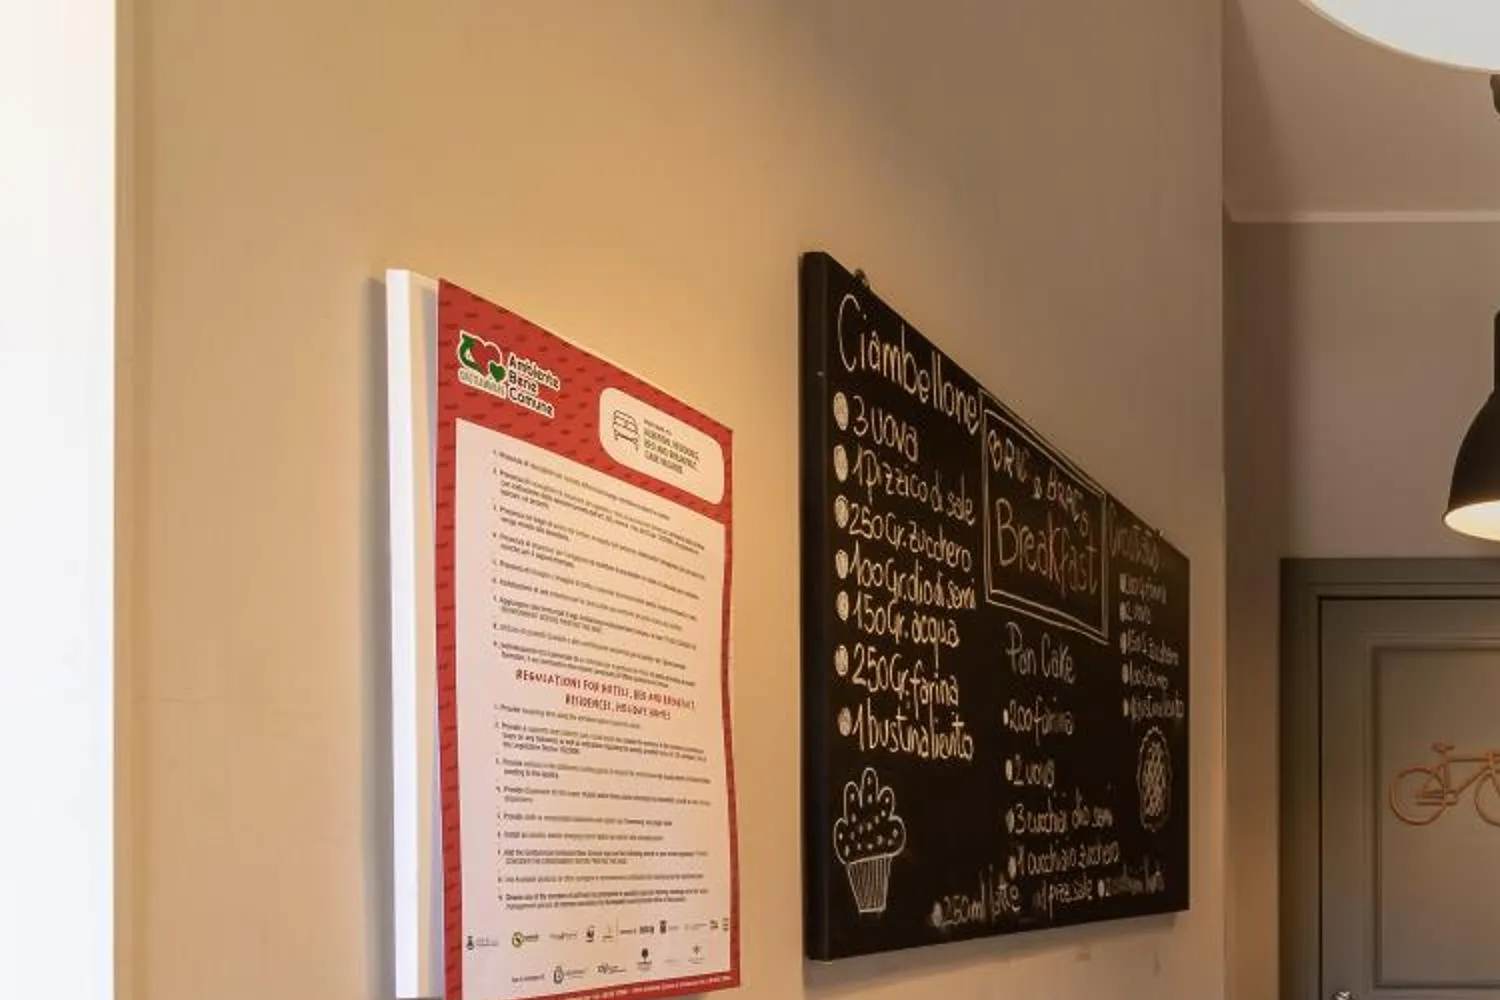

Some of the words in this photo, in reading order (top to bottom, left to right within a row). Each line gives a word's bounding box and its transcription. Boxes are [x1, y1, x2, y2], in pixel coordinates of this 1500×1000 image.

[508, 354, 560, 390] Ambiente
[508, 369, 538, 393] Bene
[837, 293, 980, 435] Ciambellone
[508, 387, 554, 416] Comune
[853, 395, 869, 436] 3
[946, 473, 976, 526] sale
[996, 497, 1098, 600] Breakfast
[912, 610, 960, 669] acqua
[1006, 621, 1037, 676] Pan
[515, 669, 581, 689] REGULATIONS
[584, 679, 599, 693] FOR
[910, 659, 959, 720] farina
